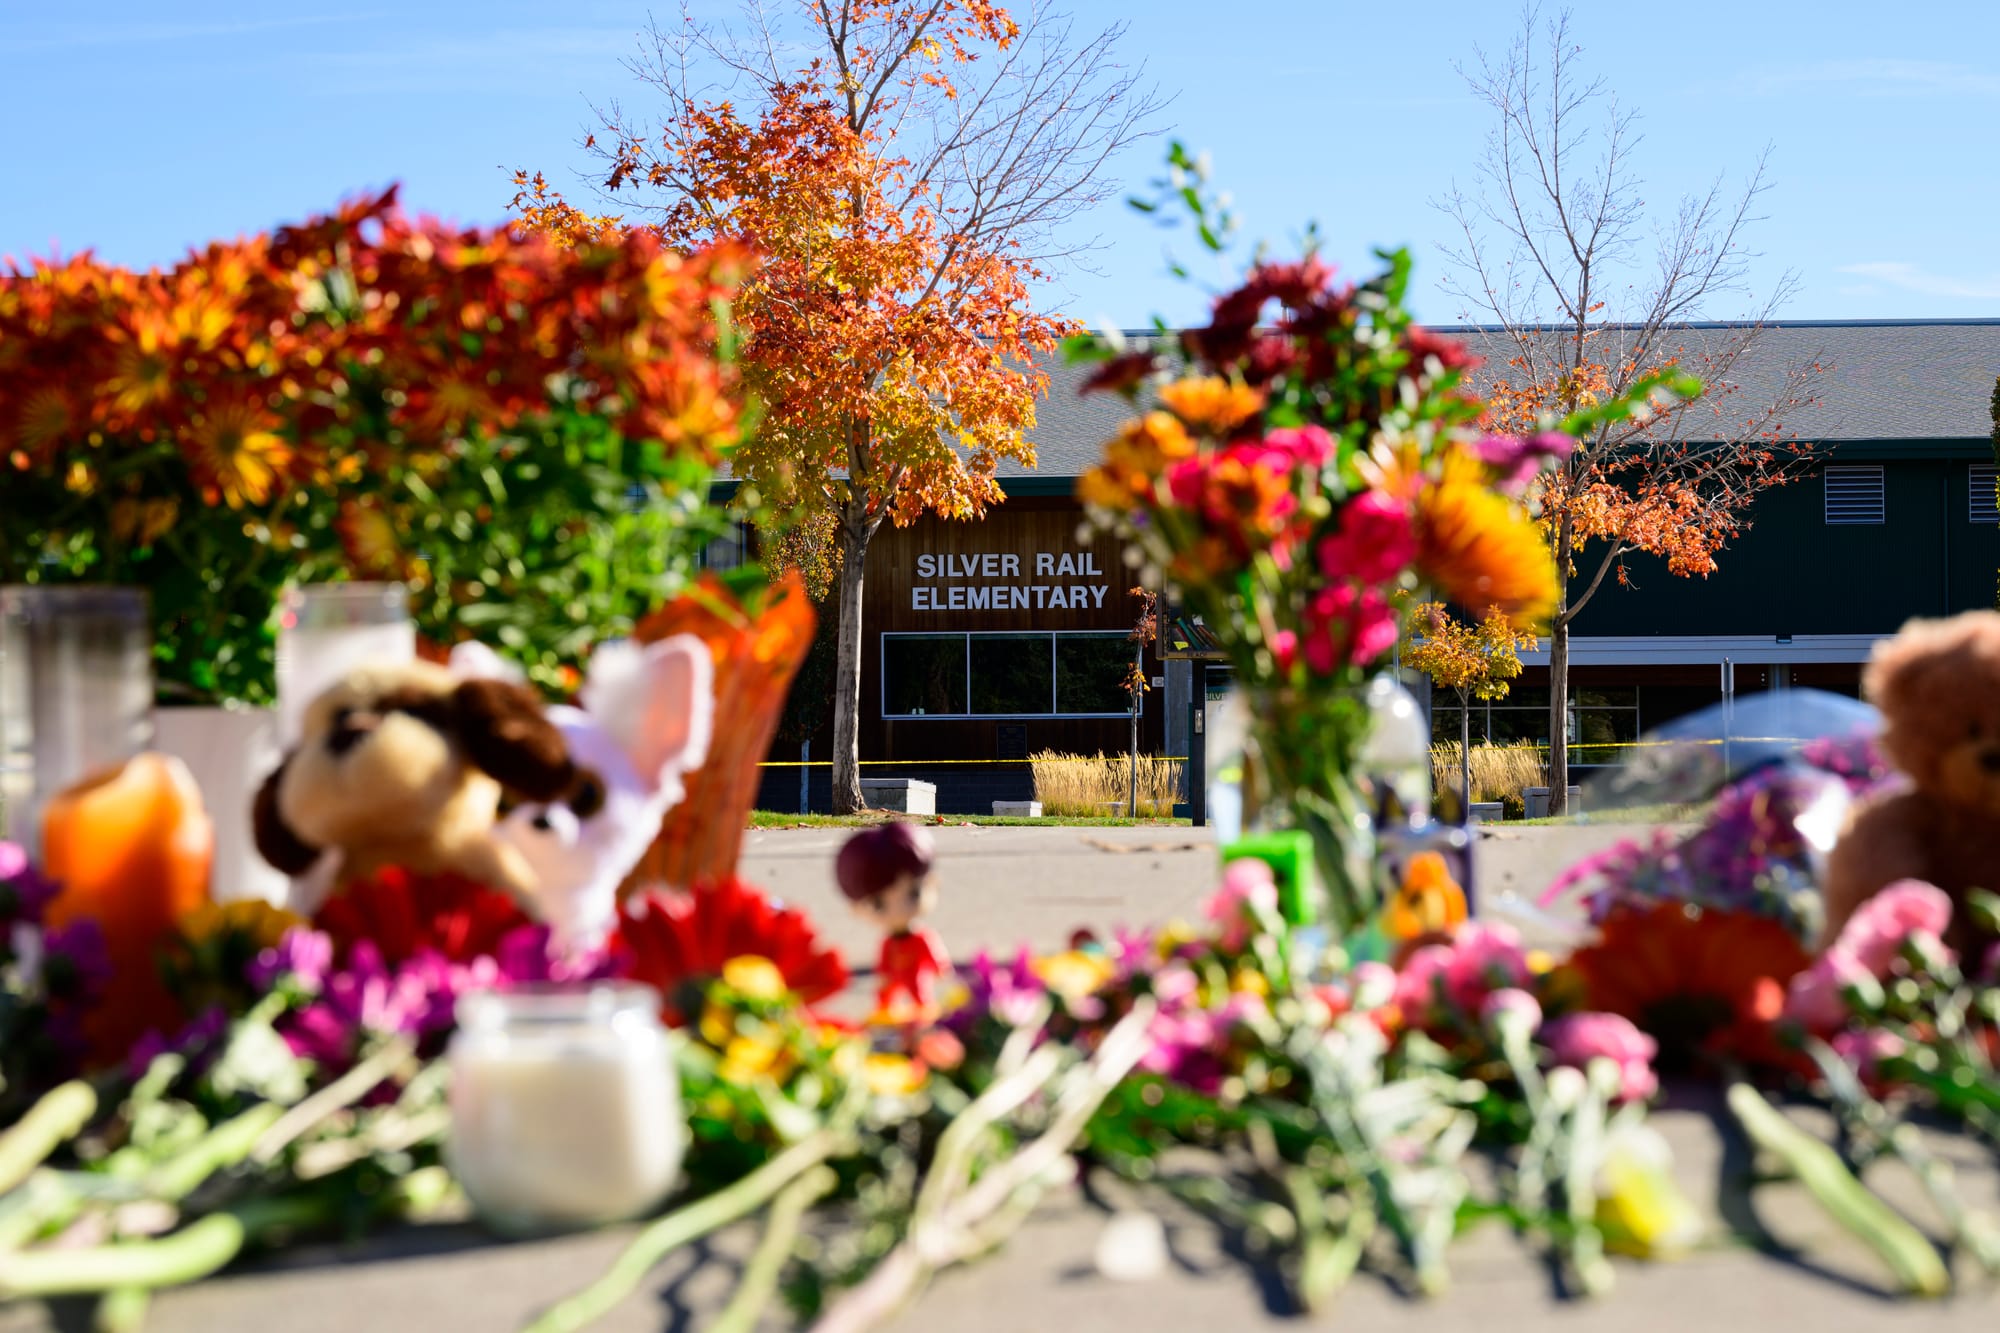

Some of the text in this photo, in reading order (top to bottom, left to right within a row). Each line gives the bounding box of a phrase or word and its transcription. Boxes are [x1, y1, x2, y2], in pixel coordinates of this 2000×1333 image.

[916, 552, 1102, 577] SILVER RAIL
[912, 585, 1109, 610] ELEMENTARY
